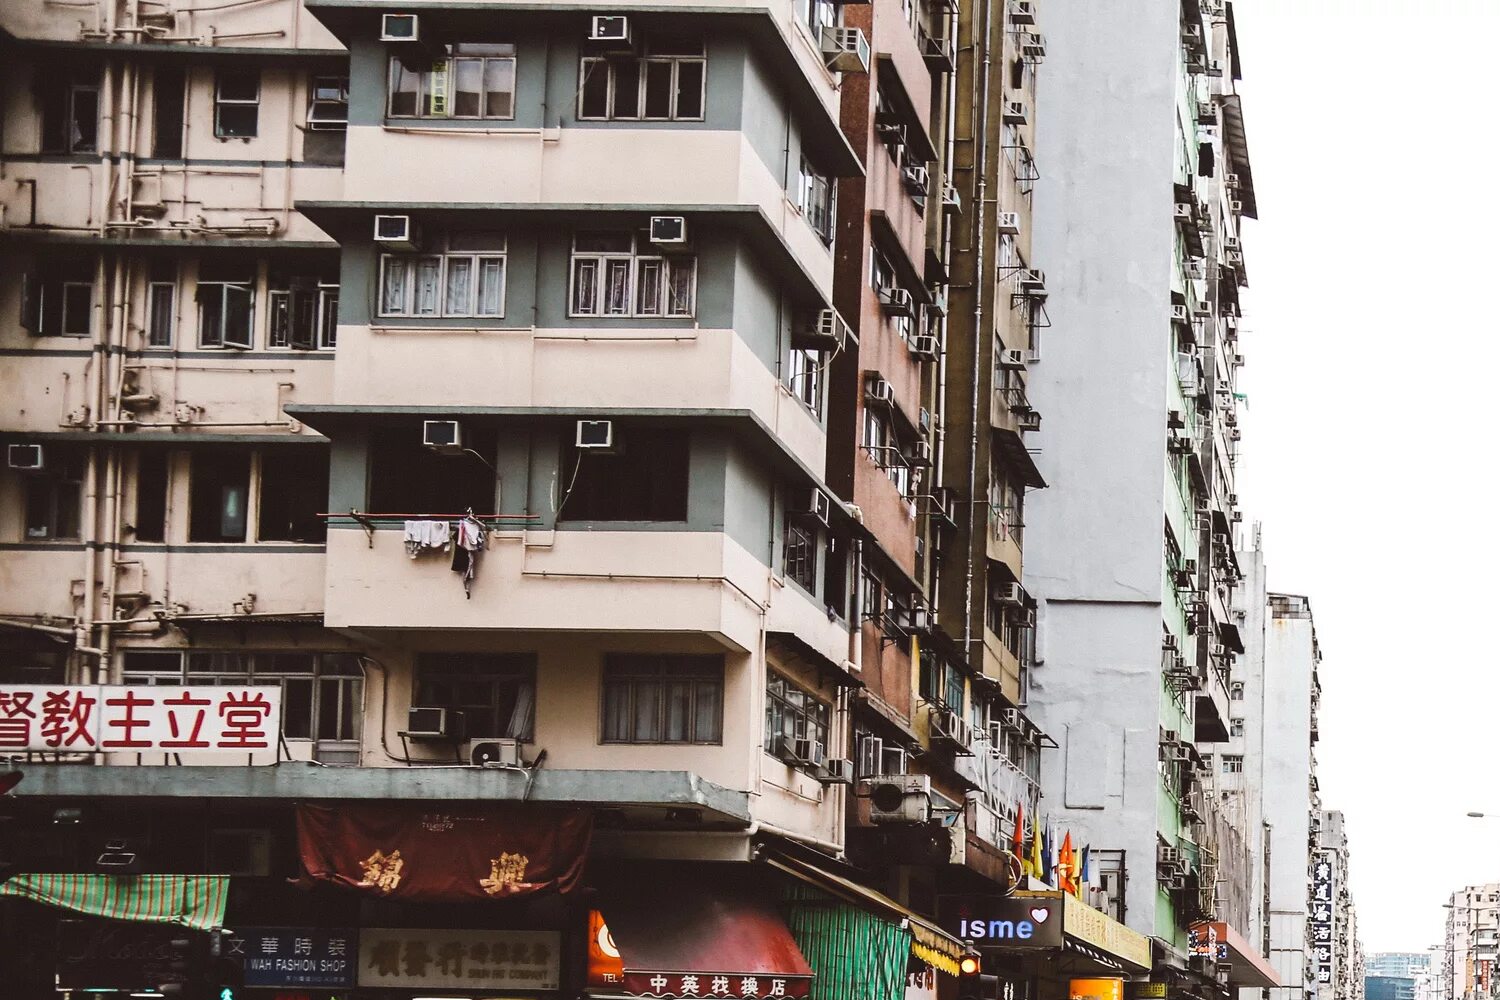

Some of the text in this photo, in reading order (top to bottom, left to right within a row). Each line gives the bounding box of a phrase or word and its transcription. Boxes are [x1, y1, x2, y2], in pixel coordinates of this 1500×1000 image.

[0, 691, 270, 747] 督教主立堂
[961, 918, 1034, 938] isme
[228, 937, 346, 956] 文華時裝
[251, 959, 346, 972] WAH FASHION SHOP
[650, 974, 787, 996] 中英找換店
